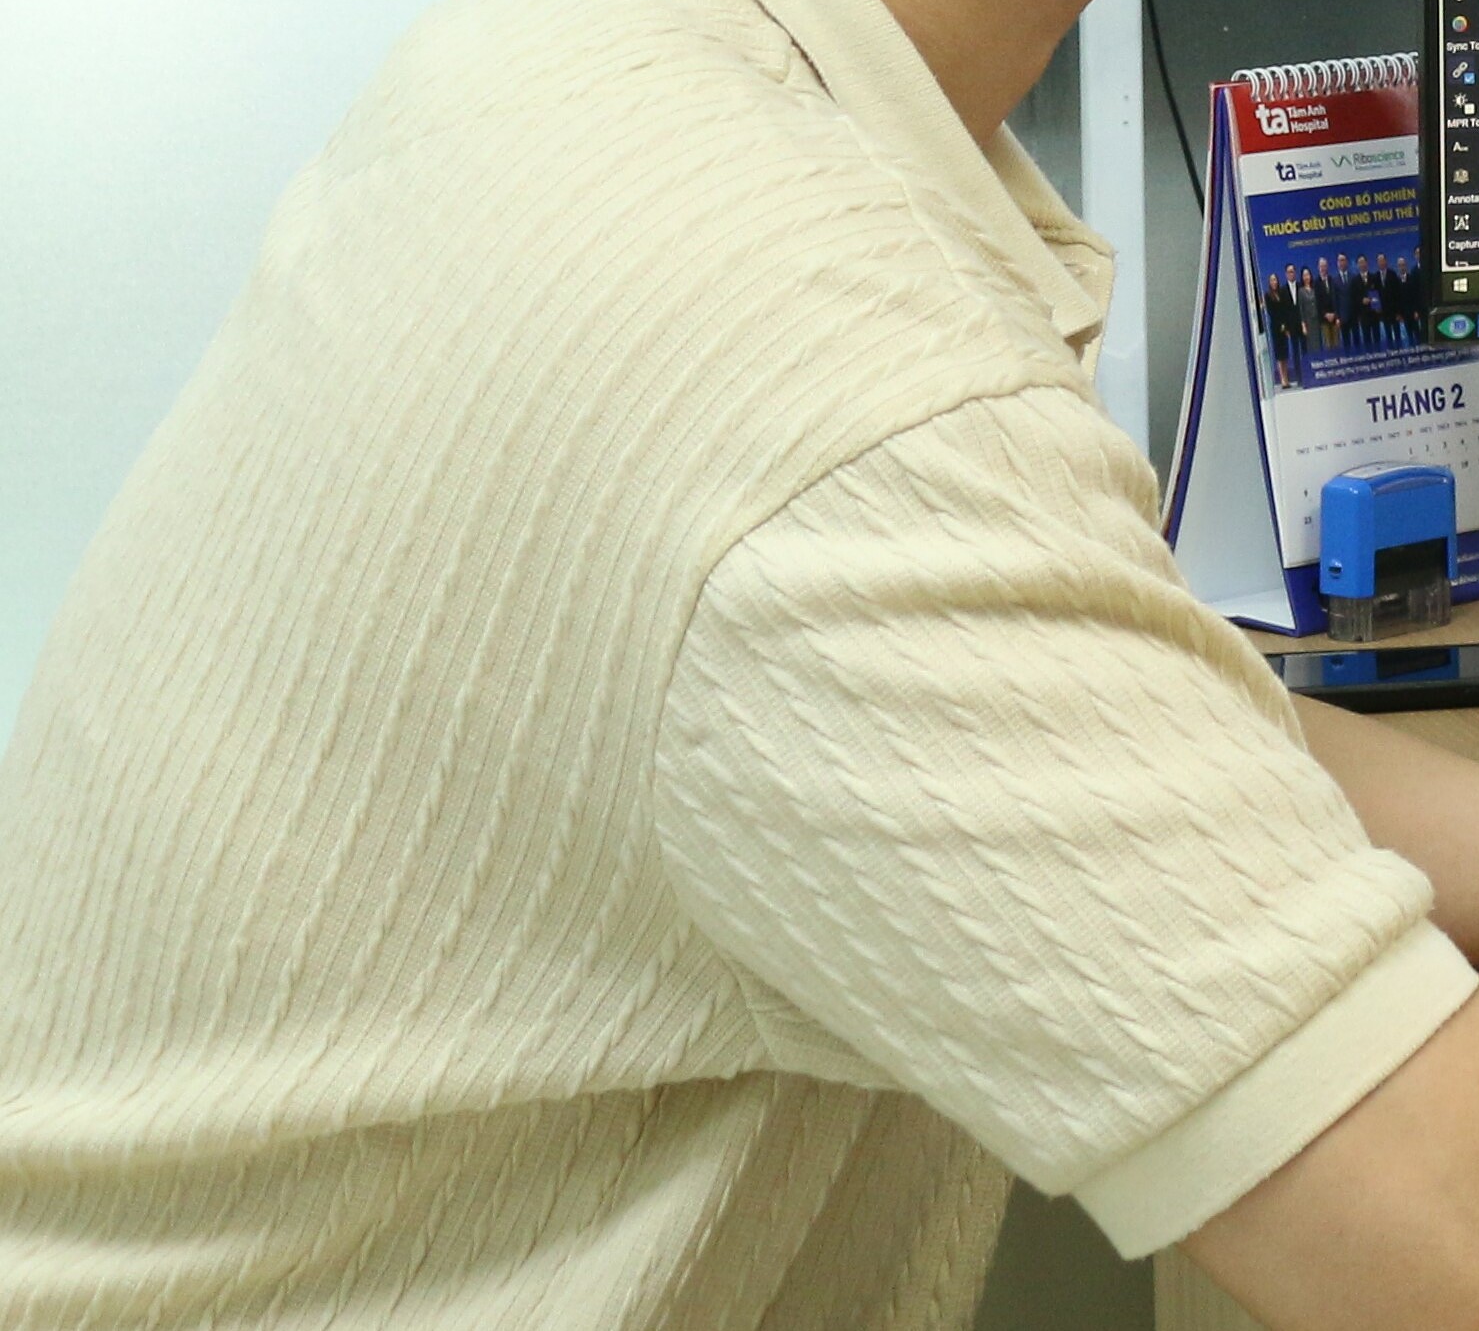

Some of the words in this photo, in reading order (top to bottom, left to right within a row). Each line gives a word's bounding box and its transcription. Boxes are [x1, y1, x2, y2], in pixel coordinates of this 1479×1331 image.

[1447, 42, 1468, 53] Sync
[1255, 104, 1290, 136] ta
[1307, 104, 1326, 116] Anh
[1290, 118, 1329, 134] Hospital
[1448, 118, 1468, 129] MPR
[1275, 161, 1296, 182] ta
[1366, 385, 1446, 423] THÁNG
[1450, 383, 1465, 409] 2
